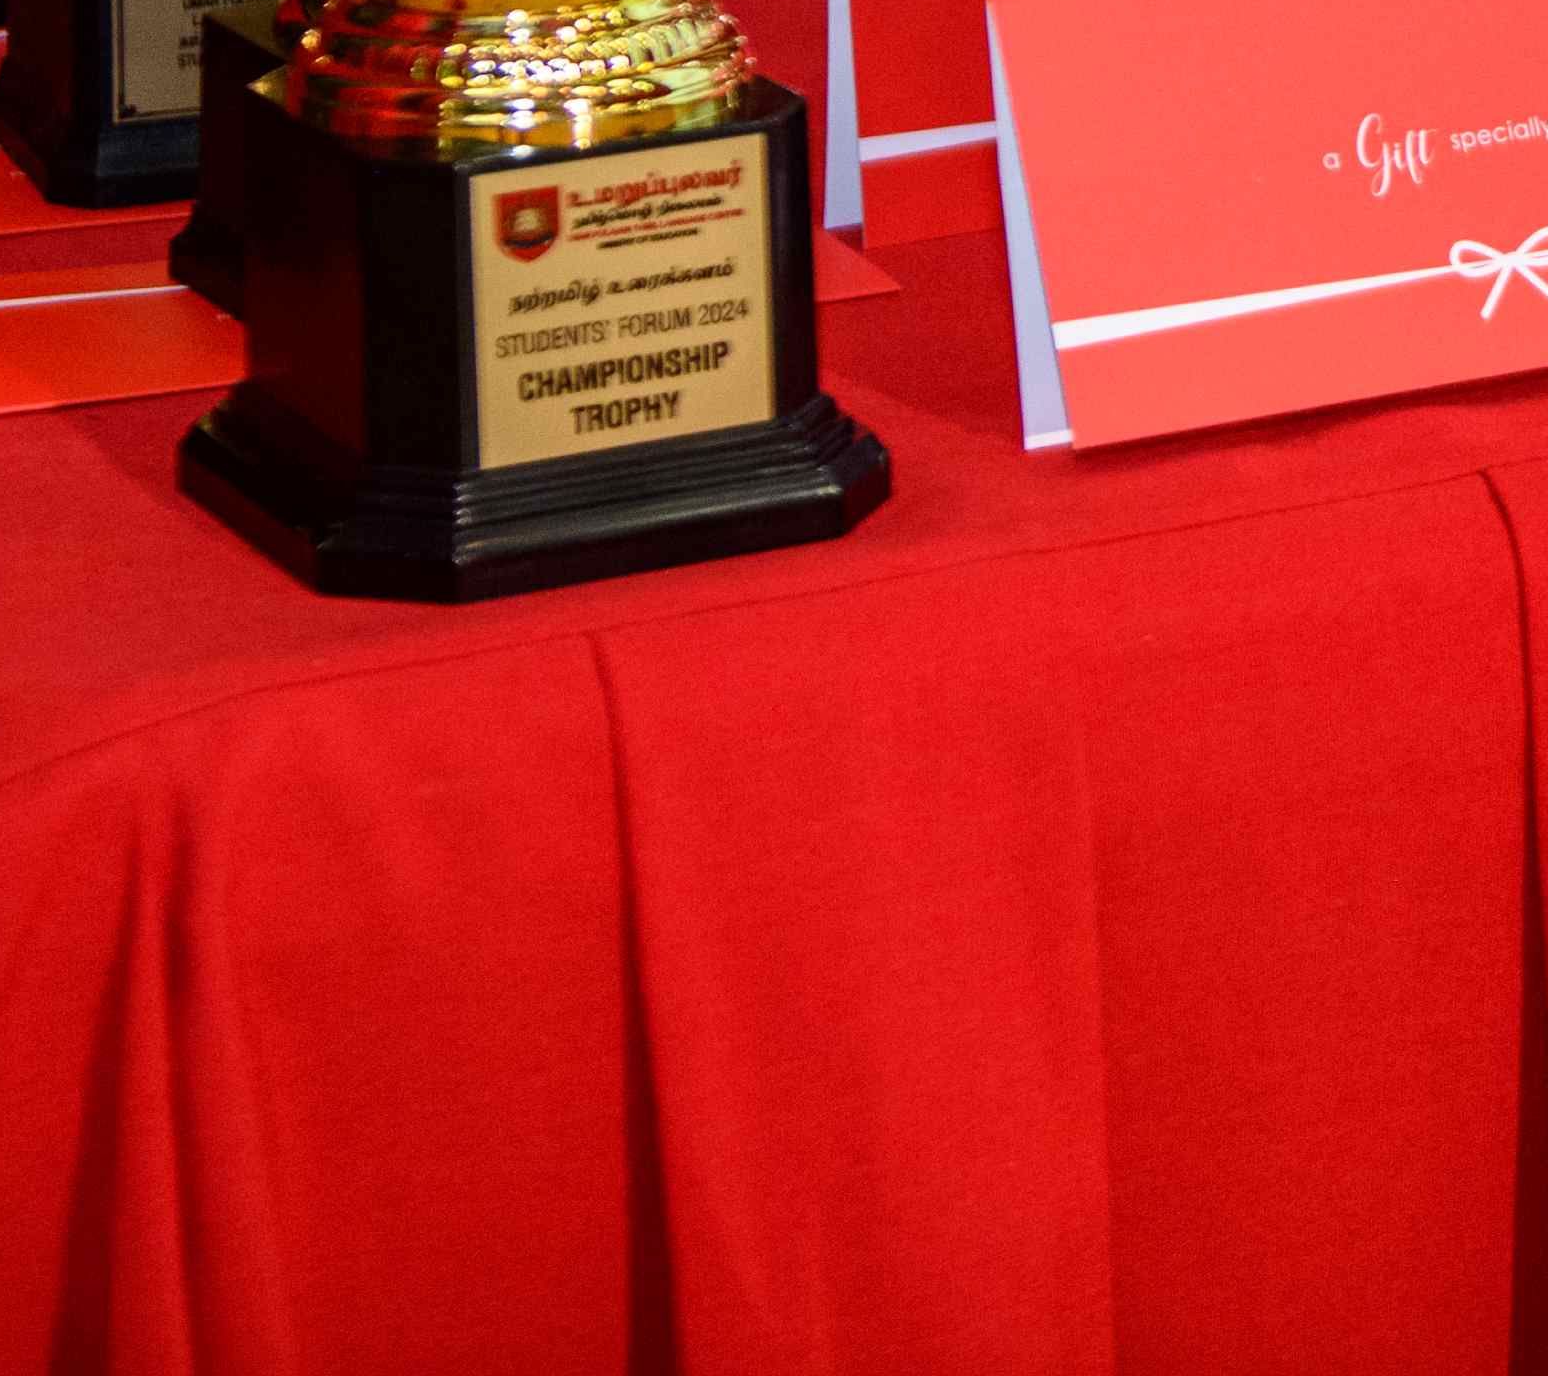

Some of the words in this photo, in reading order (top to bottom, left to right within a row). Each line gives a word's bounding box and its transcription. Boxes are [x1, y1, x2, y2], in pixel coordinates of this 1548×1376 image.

[1322, 152, 1341, 170] a
[1355, 112, 1437, 197] Gift
[495, 319, 612, 359] STUDENTS'
[617, 306, 692, 339] FORUM
[698, 297, 750, 327] 2024
[517, 340, 731, 402] CHAMPIONSHIP
[570, 390, 681, 435] TROPHY
